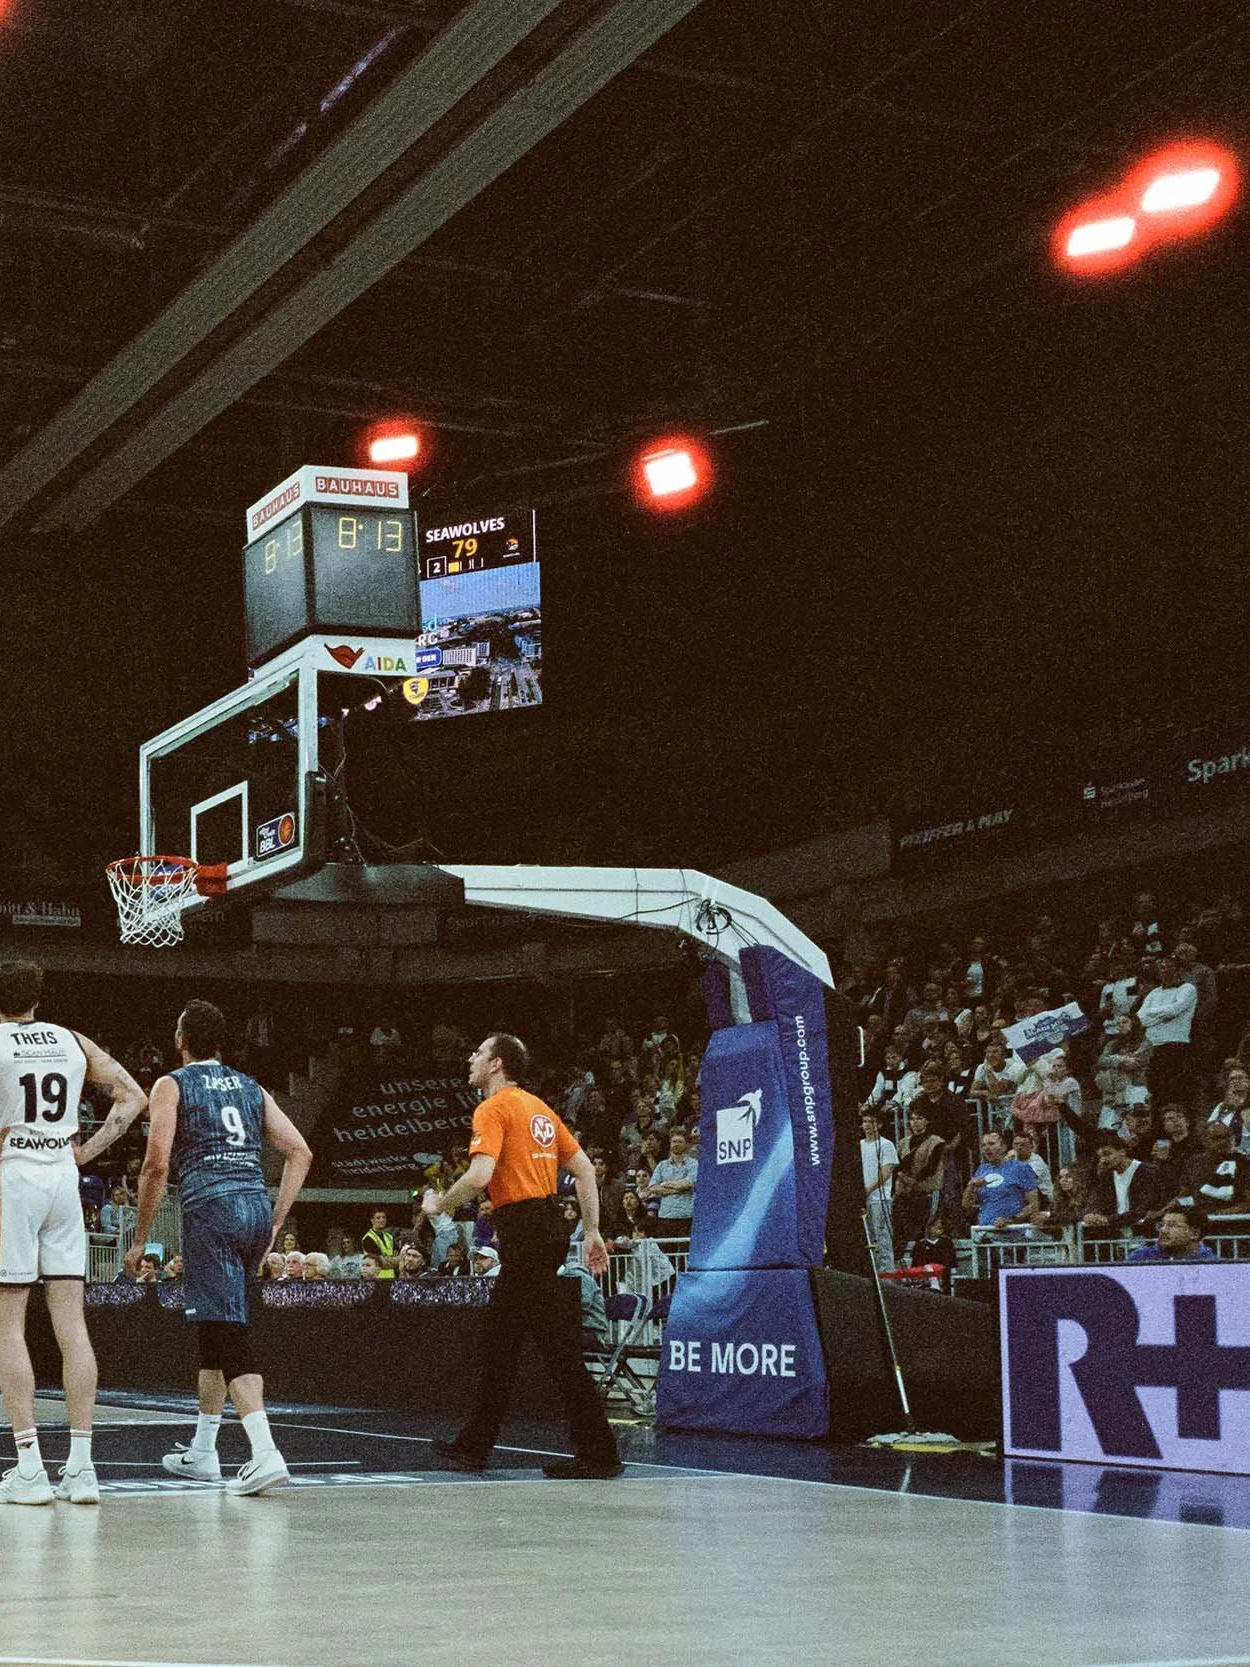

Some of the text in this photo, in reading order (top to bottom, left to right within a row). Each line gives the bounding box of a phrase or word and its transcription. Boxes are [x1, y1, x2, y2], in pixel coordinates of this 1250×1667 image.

[316, 476, 399, 498] BAUHAUS
[252, 482, 300, 530] BAUHAUS
[425, 517, 505, 543] SEAWOLVES
[452, 538, 477, 559] 79
[433, 562, 441, 574] 2
[364, 656, 407, 672] AIDA
[259, 836, 276, 854] BBL
[25, 902, 37, 915] &
[10, 1031, 58, 1046] THEIS
[380, 1077, 465, 1095] unsere
[796, 1014, 821, 1166] www.snpgroup.com
[18, 1072, 68, 1123] 19
[352, 1096, 448, 1118] energie
[221, 1106, 246, 1146] 9
[333, 1115, 472, 1143] heidelberg
[10, 1137, 70, 1150] SEAWOLV
[719, 1140, 753, 1161] SNP
[669, 1340, 796, 1377] BE MORE
